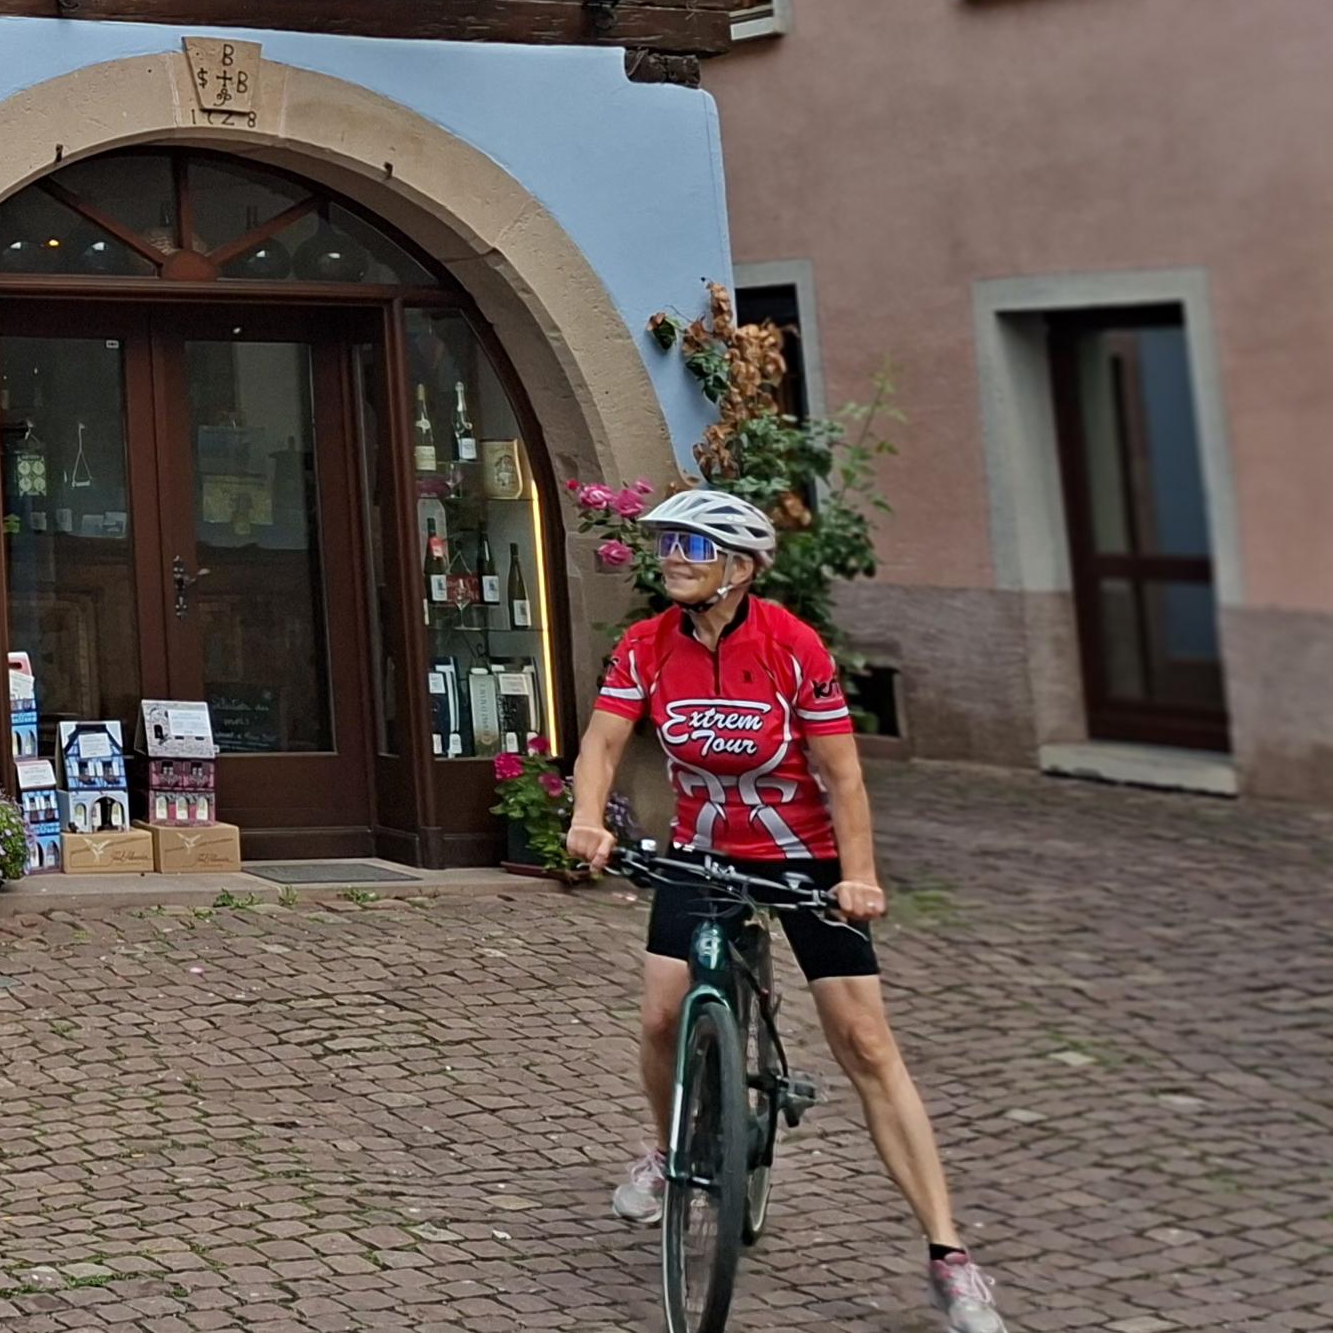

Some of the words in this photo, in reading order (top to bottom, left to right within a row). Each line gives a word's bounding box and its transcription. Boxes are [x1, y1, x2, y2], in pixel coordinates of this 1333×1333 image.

[222, 43, 235, 66] B
[236, 70, 249, 94] B
[661, 699, 772, 744] Extrem
[691, 729, 757, 756] Tour
